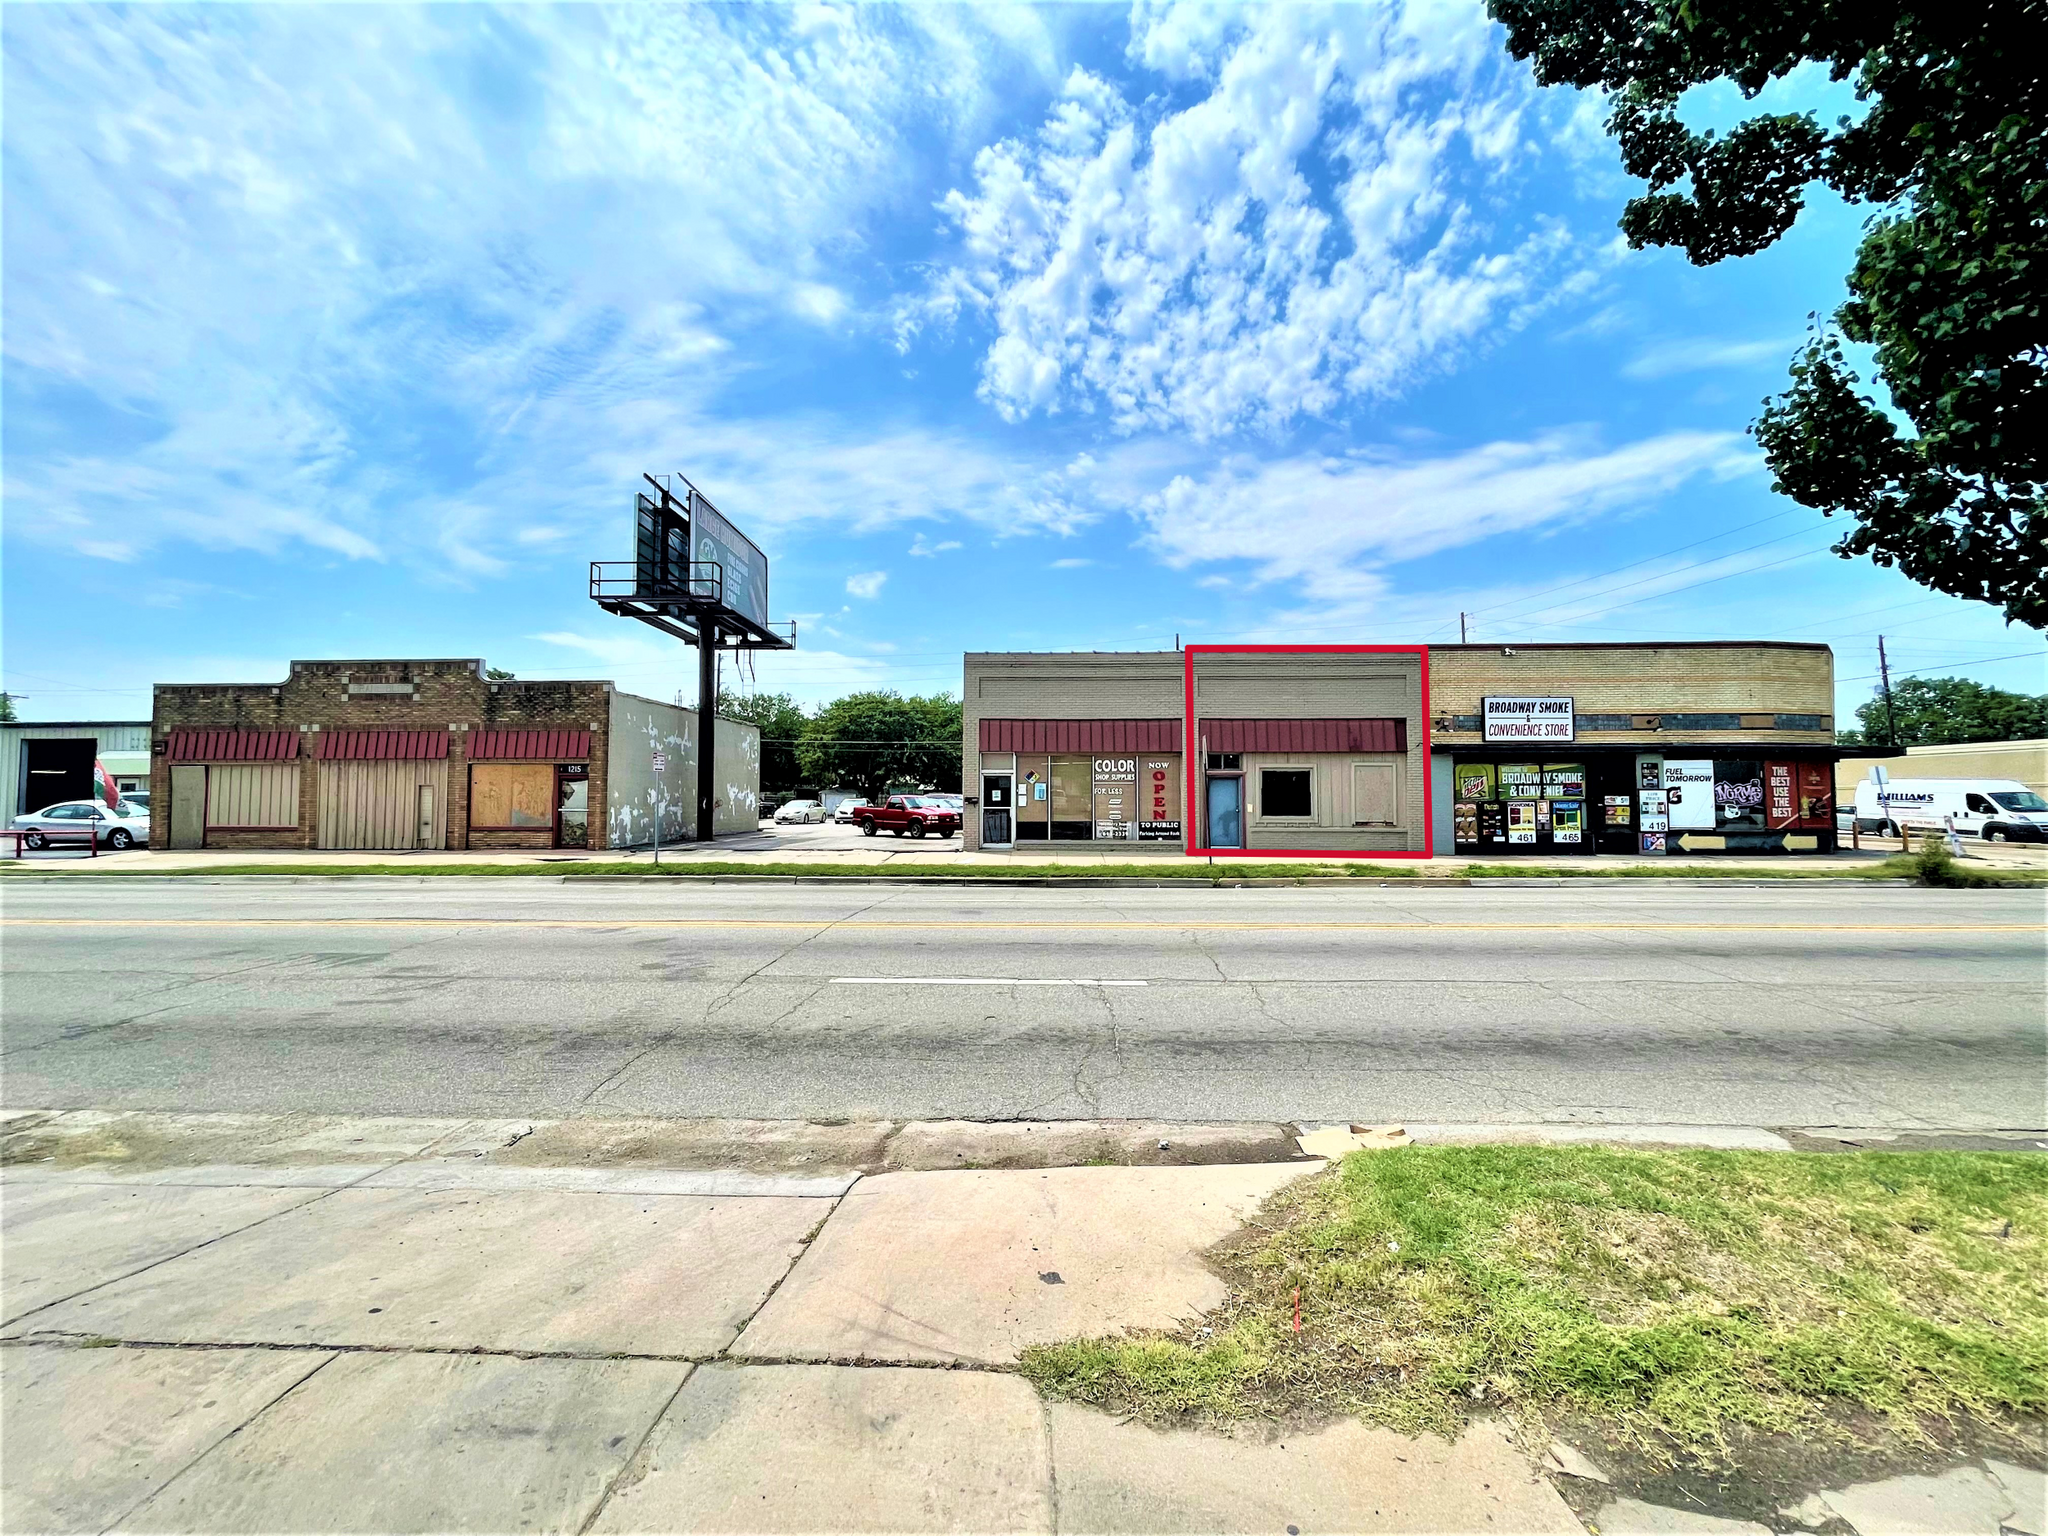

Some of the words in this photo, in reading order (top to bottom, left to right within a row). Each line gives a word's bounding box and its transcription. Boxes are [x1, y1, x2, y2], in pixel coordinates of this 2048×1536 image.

[697, 503, 721, 540] LARGE
[1488, 702, 1536, 713] BROADWAY
[1539, 702, 1570, 713] SMOKE
[1526, 714, 1531, 722] &
[1489, 724, 1542, 736] CONVENIENCE
[1545, 724, 1569, 736] STORE
[1095, 760, 1135, 772] COLOR
[1771, 766, 1788, 776] THE
[1552, 773, 1583, 784] SMOKE
[1770, 777, 1791, 787] BEST
[1152, 771, 1167, 820] OPEN
[1510, 785, 1518, 797] &
[1773, 787, 1789, 797] USE
[1773, 797, 1790, 807] THE
[1877, 793, 1934, 801] WILLIAMS
[1772, 808, 1793, 818] BEST
[1648, 822, 1666, 830] 419
[1517, 834, 1533, 842] 461
[1562, 833, 1580, 841] 465
